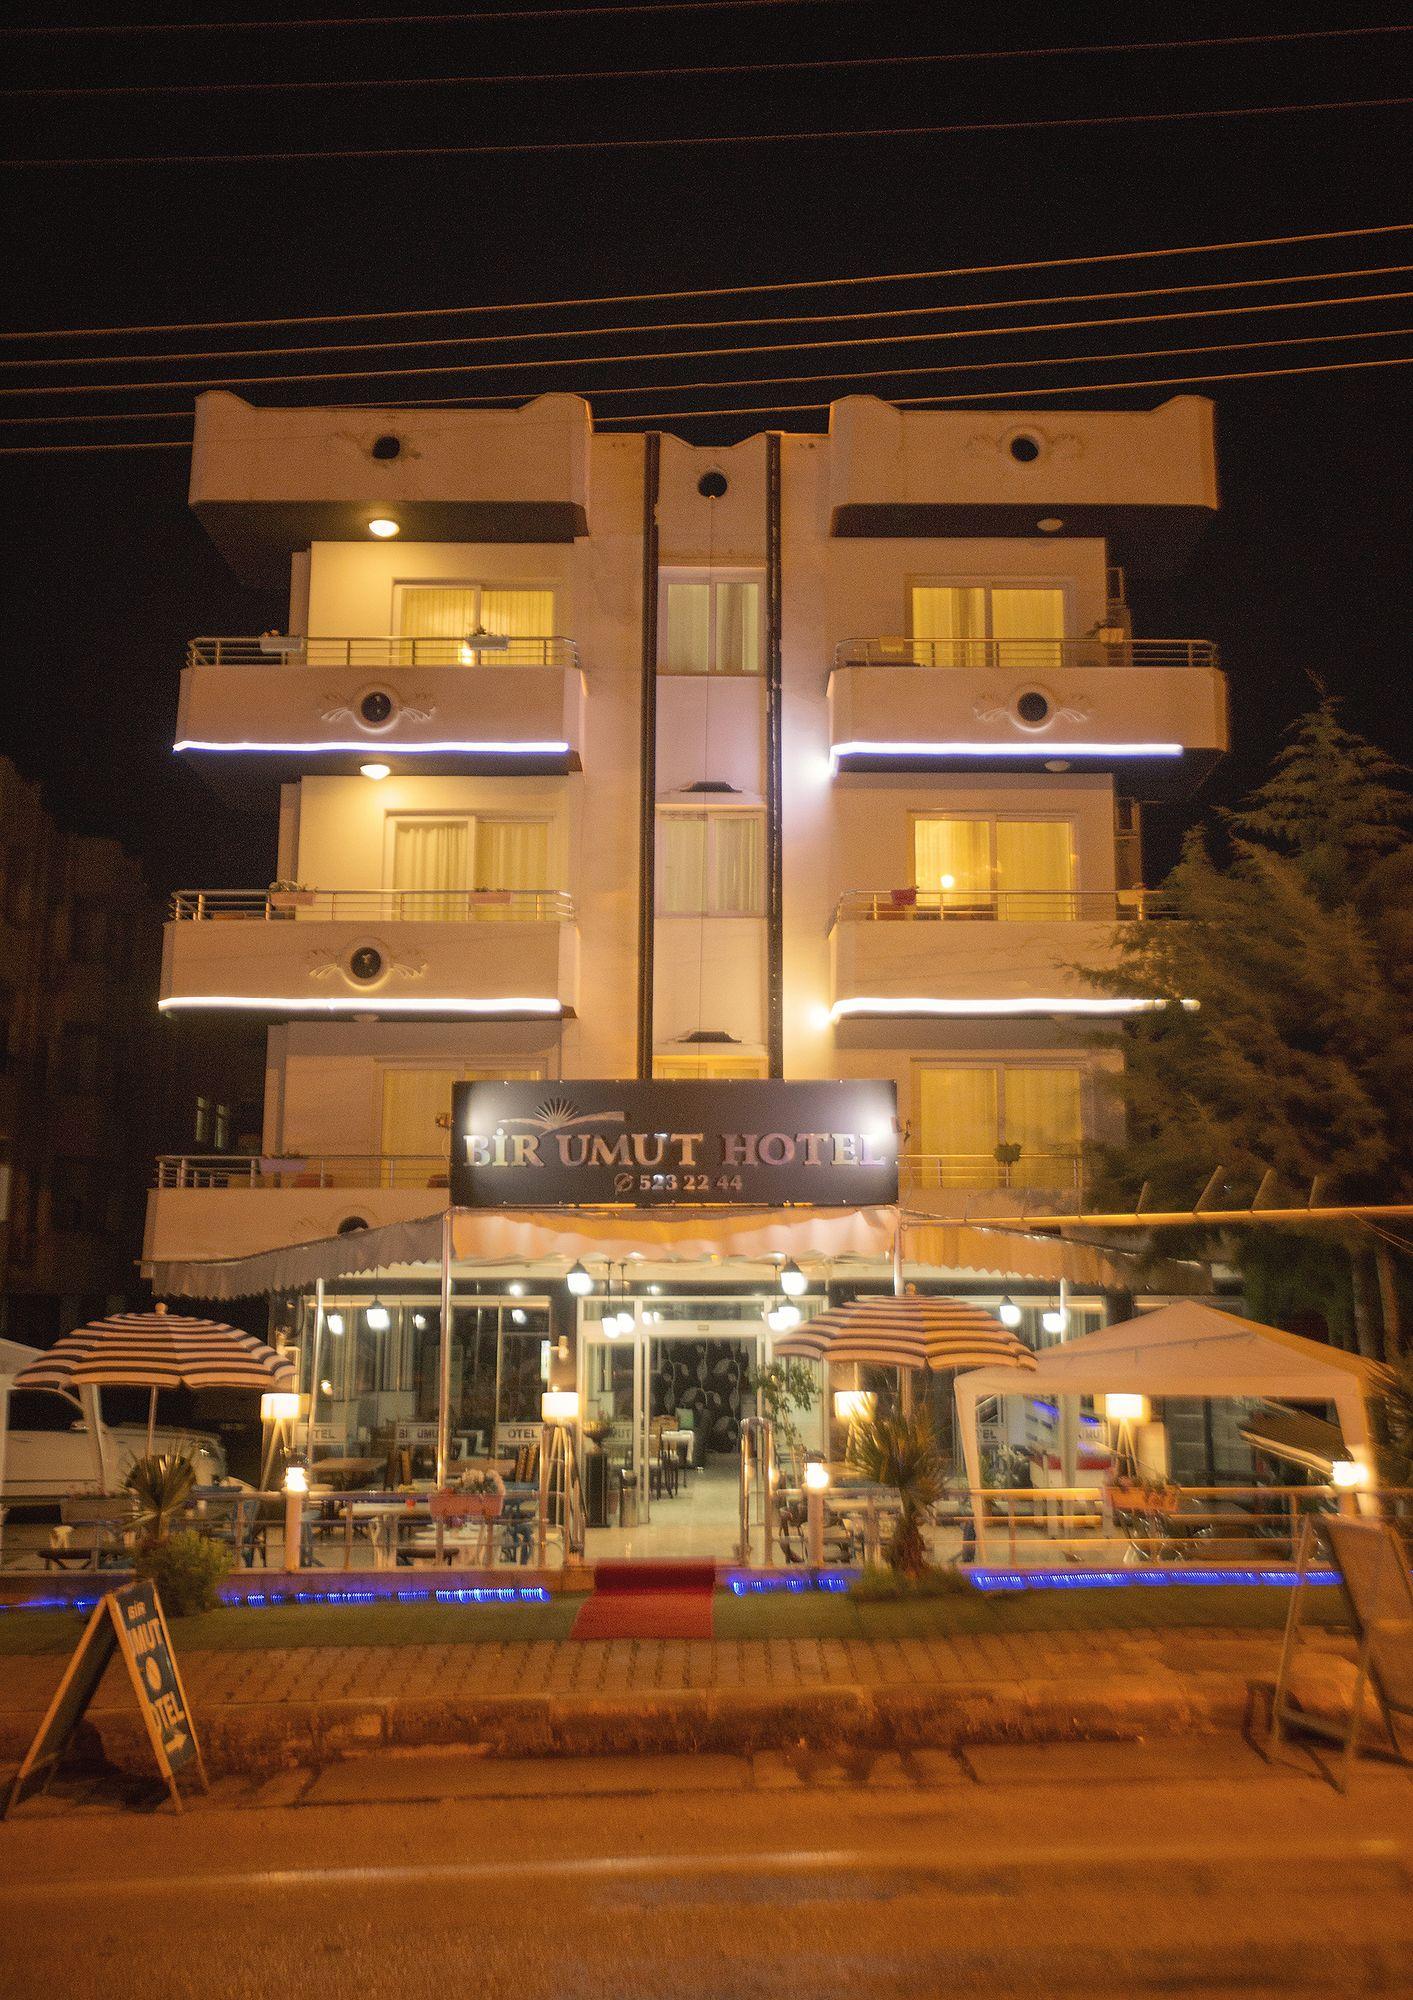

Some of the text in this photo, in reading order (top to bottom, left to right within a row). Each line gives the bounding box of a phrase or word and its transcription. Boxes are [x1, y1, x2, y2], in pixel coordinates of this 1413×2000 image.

[463, 1128, 887, 1167] BİR UMUT HOTEL
[639, 1174, 743, 1191] 523 22 44
[313, 1429, 336, 1439] TEL
[417, 1428, 438, 1439] UMU
[507, 1428, 538, 1439] OTEL
